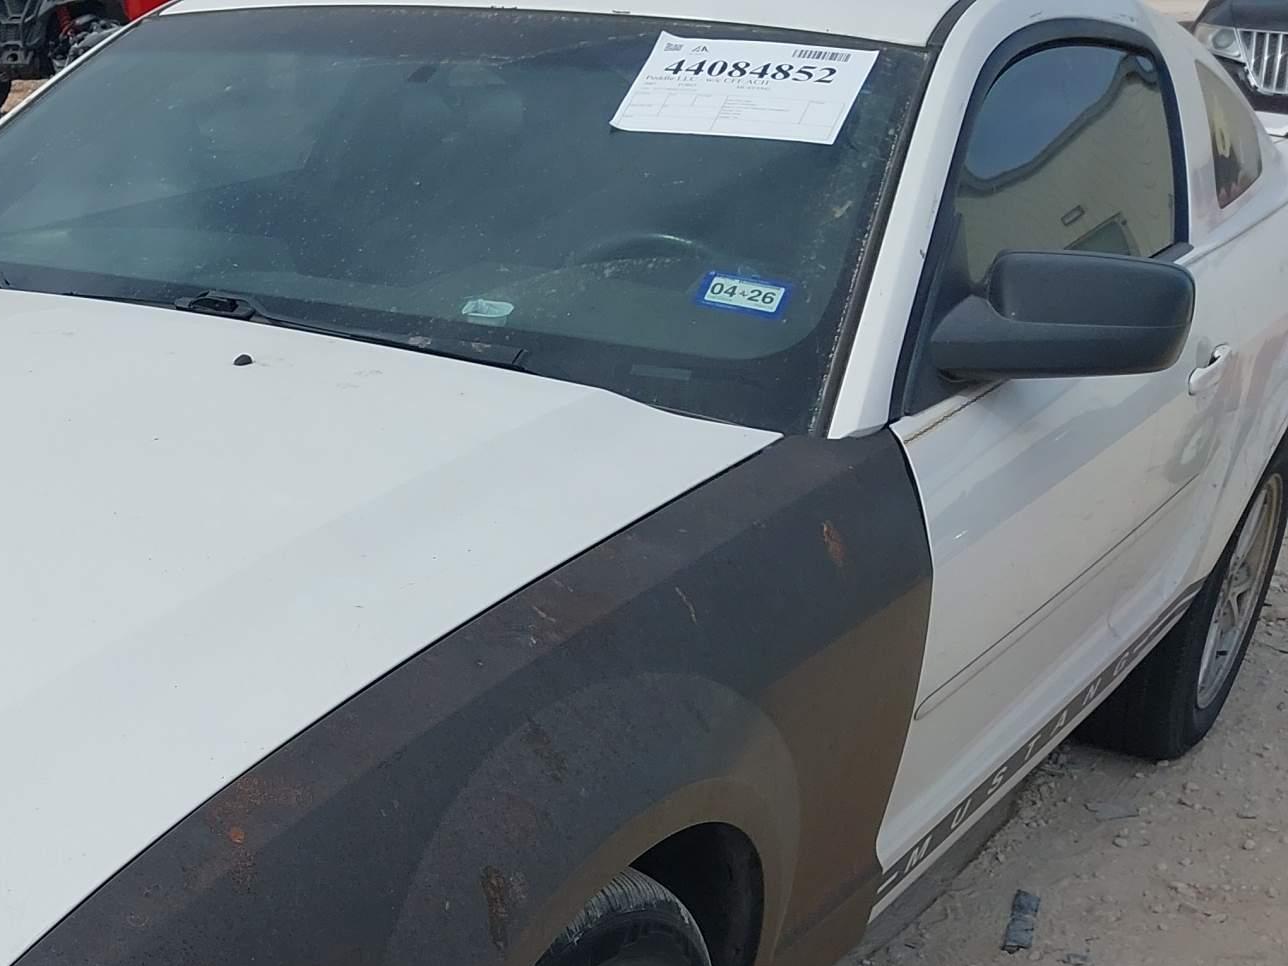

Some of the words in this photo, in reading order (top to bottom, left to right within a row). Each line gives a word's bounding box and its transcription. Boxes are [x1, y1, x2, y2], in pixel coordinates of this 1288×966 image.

[664, 59, 837, 84] 44084852
[710, 283, 738, 298] 04
[747, 289, 777, 304] 26
[904, 651, 1130, 871] MUSTANG
